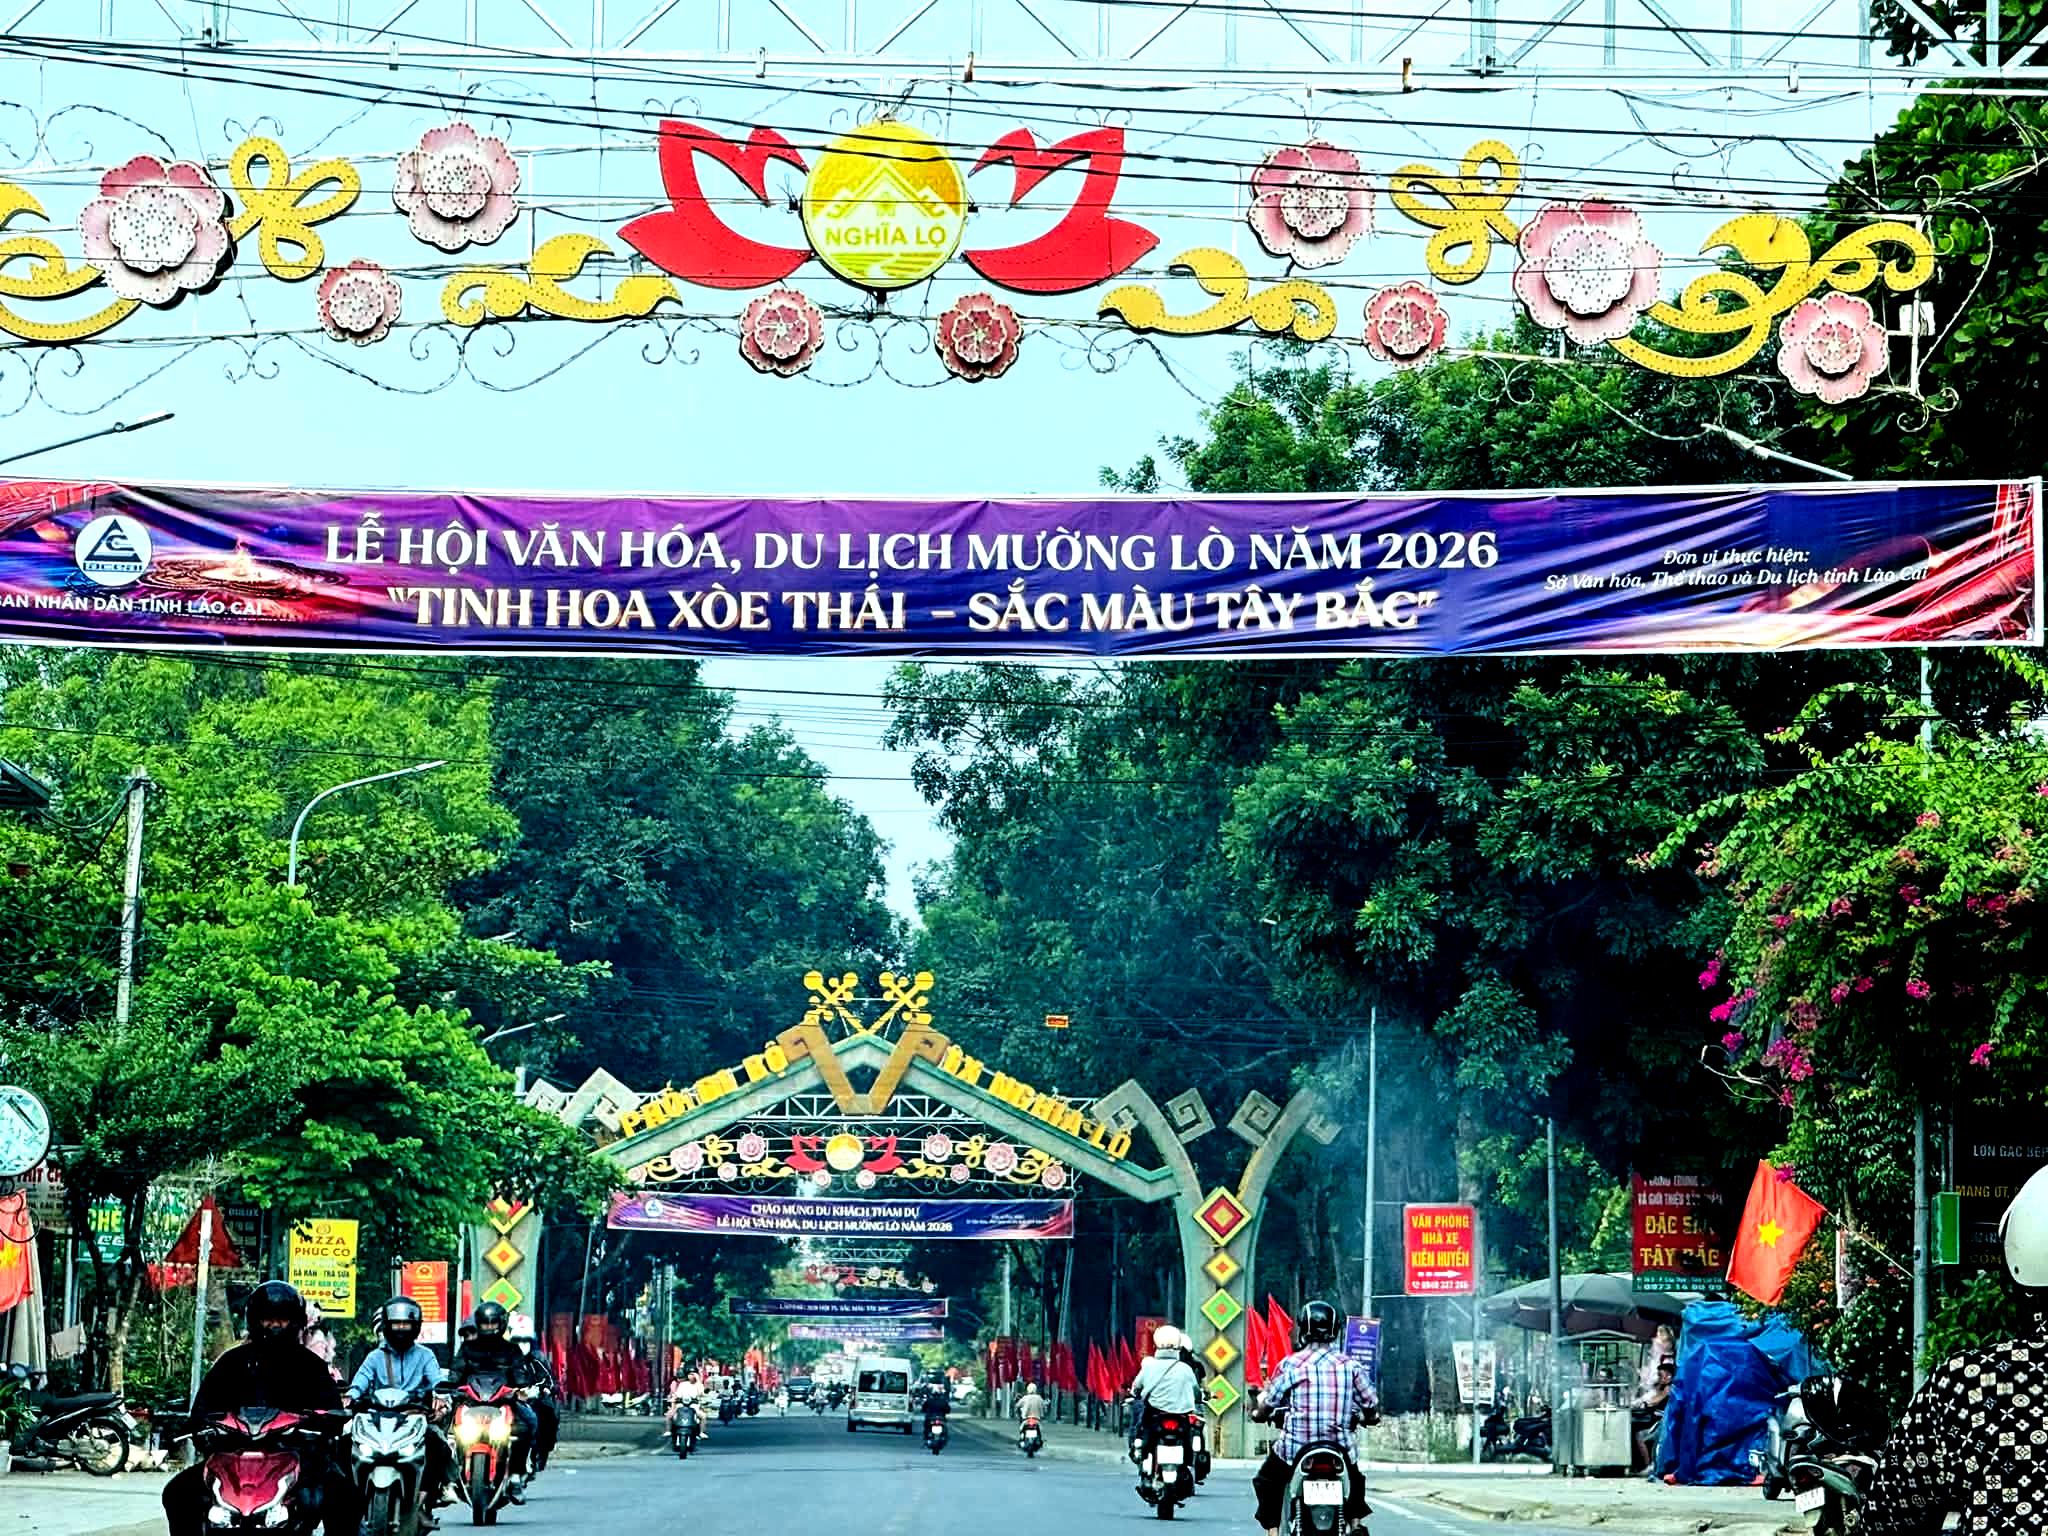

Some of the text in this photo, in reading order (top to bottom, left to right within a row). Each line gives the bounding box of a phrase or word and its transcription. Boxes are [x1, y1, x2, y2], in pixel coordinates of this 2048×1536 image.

[826, 222, 908, 246] NGHĨA
[325, 512, 1500, 580] LỄ HỘI VĂN HÓA, DU LỊCH MƯỜNG LÒ NĂM 2026
[1664, 548, 1811, 567] Đơn vị thực hiện:
[1544, 566, 1929, 591] Sở Văn hóa, Thể thao và Du lịch tỉnh Lào Cai
[34, 593, 88, 612] NHÂN
[93, 594, 133, 612] DÂN
[140, 594, 182, 615] TỈNH
[230, 602, 263, 616] CAI
[546, 588, 656, 629] HOA
[667, 583, 772, 632] XÒE
[782, 584, 908, 631] THÁI
[968, 577, 1070, 632] SẮC
[1080, 584, 1196, 632] MÀU
[1205, 584, 1306, 631] TÂY
[815, 1205, 831, 1217] DU
[871, 1206, 902, 1217] THAM
[1434, 1212, 1470, 1229] PHÒNG
[802, 1219, 817, 1230] DU
[901, 1219, 926, 1232] NĂM
[927, 1221, 953, 1232] 2026
[1645, 1211, 1678, 1239] ĐẶC
[1422, 1229, 1460, 1245] NHÀ XE
[1411, 1247, 1435, 1268] KIÊN
[1640, 1243, 1676, 1267] TÂY
